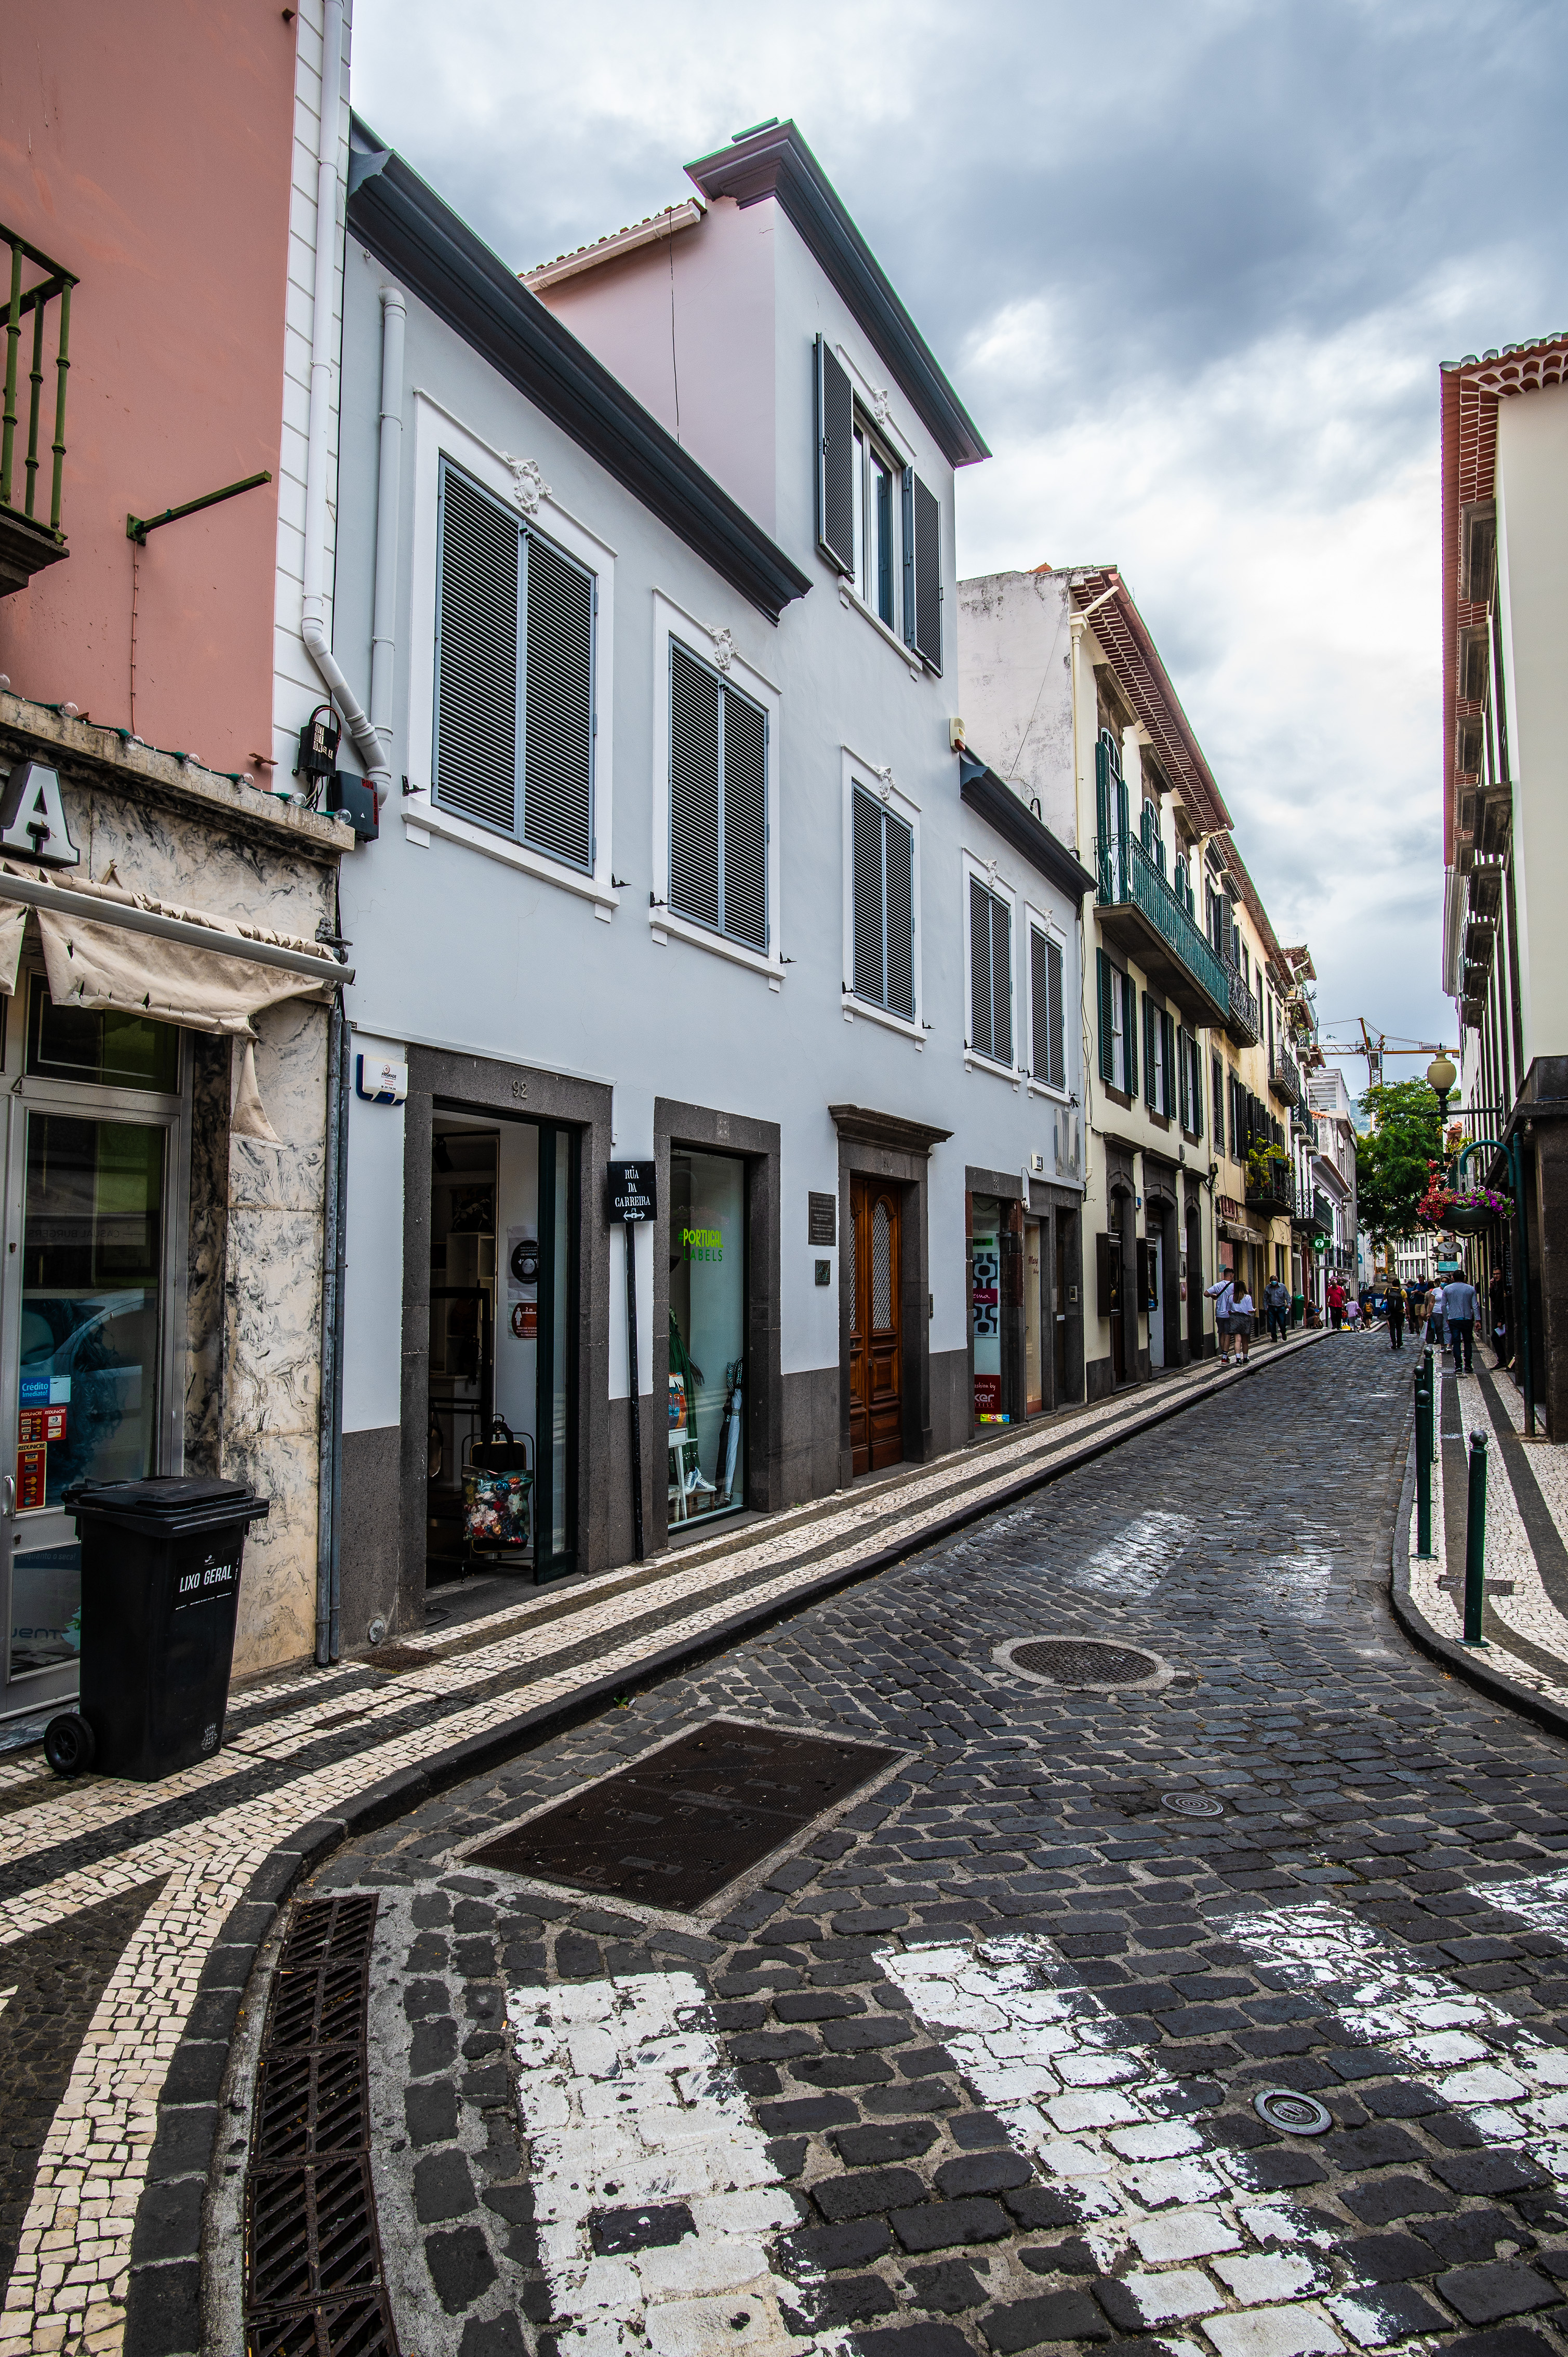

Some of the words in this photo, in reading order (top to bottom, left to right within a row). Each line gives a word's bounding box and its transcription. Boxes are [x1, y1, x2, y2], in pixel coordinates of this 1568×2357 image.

[2, 762, 79, 864] A
[11, 1076, 25, 1095] 4
[513, 1080, 528, 1098] 92
[628, 1182, 637, 1193] DA
[615, 1196, 651, 1207] CARREIRA
[677, 1228, 724, 1249] #PORTUGAL
[683, 1248, 723, 1262] LABELS
[22, 1382, 49, 1392] Crédito
[22, 1389, 48, 1398] Imediato!
[990, 1382, 996, 1391] by
[179, 1573, 201, 1593] LIXO
[203, 1565, 232, 1585] GERAL
